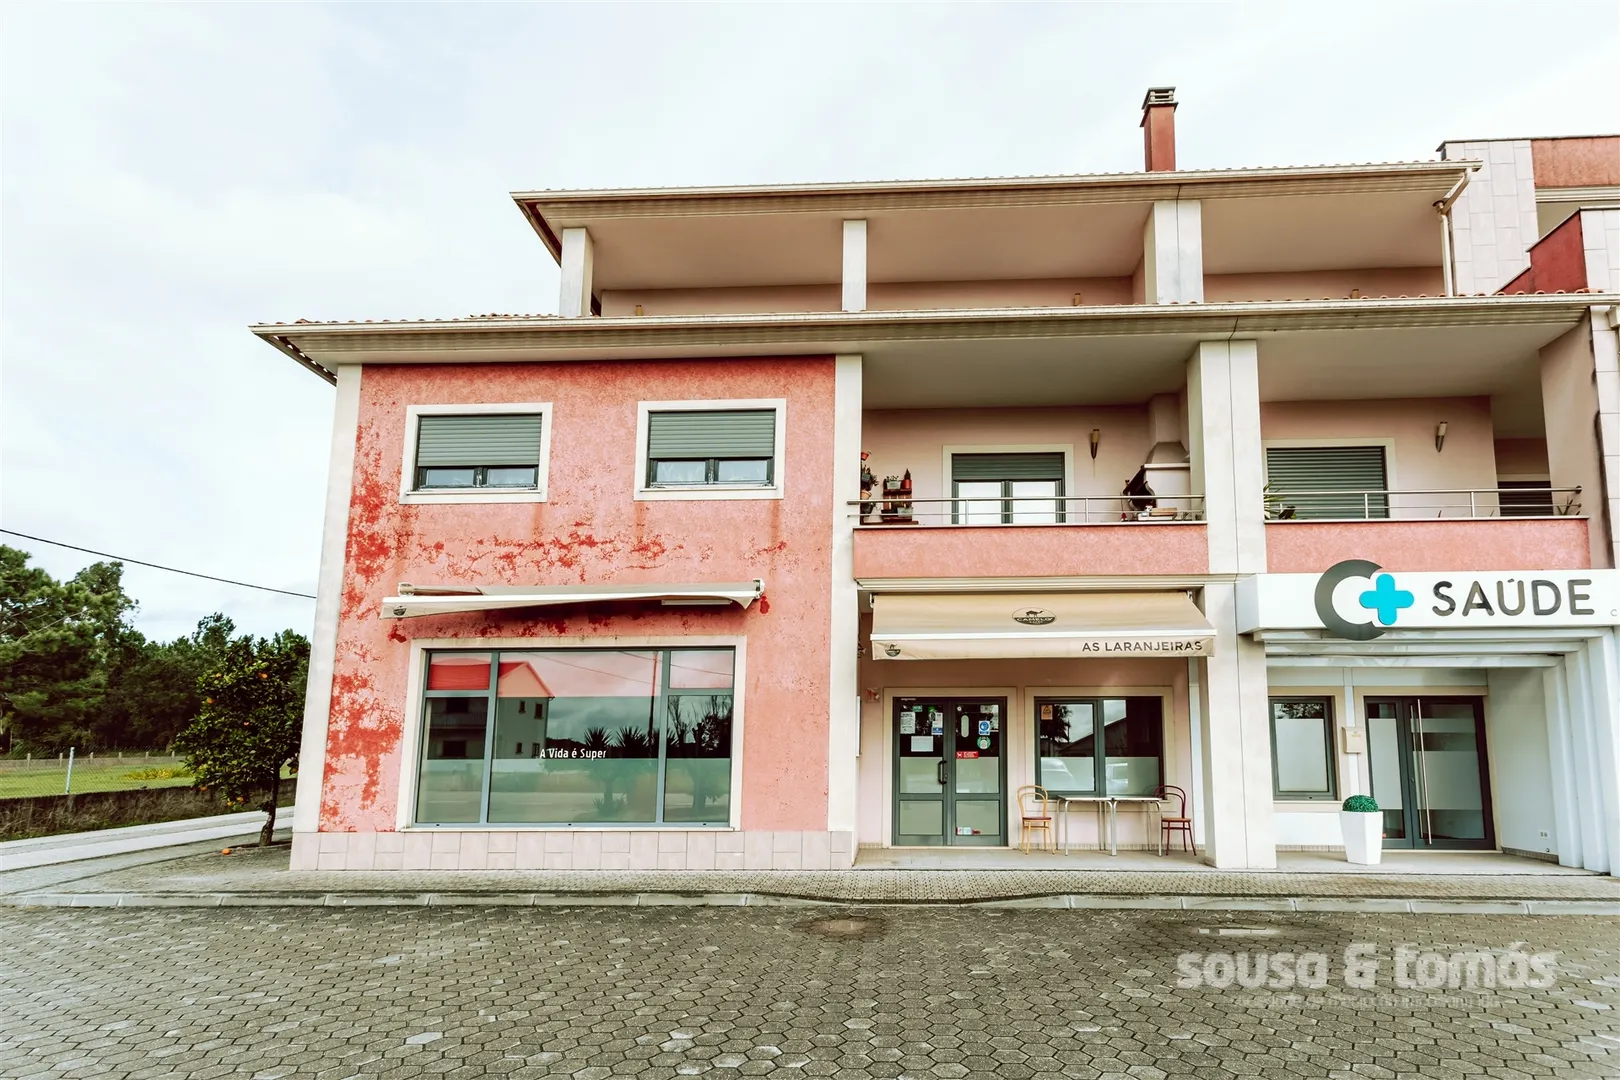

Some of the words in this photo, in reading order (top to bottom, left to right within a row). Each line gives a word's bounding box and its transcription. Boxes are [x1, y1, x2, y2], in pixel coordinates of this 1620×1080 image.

[1432, 578, 1595, 617] SAÚDE
[1082, 642, 1100, 652] AS
[1105, 641, 1203, 652] LARANJEIRAS
[540, 748, 546, 758] A
[547, 748, 569, 758] Vida
[571, 748, 577, 758] é
[580, 748, 607, 761] Super
